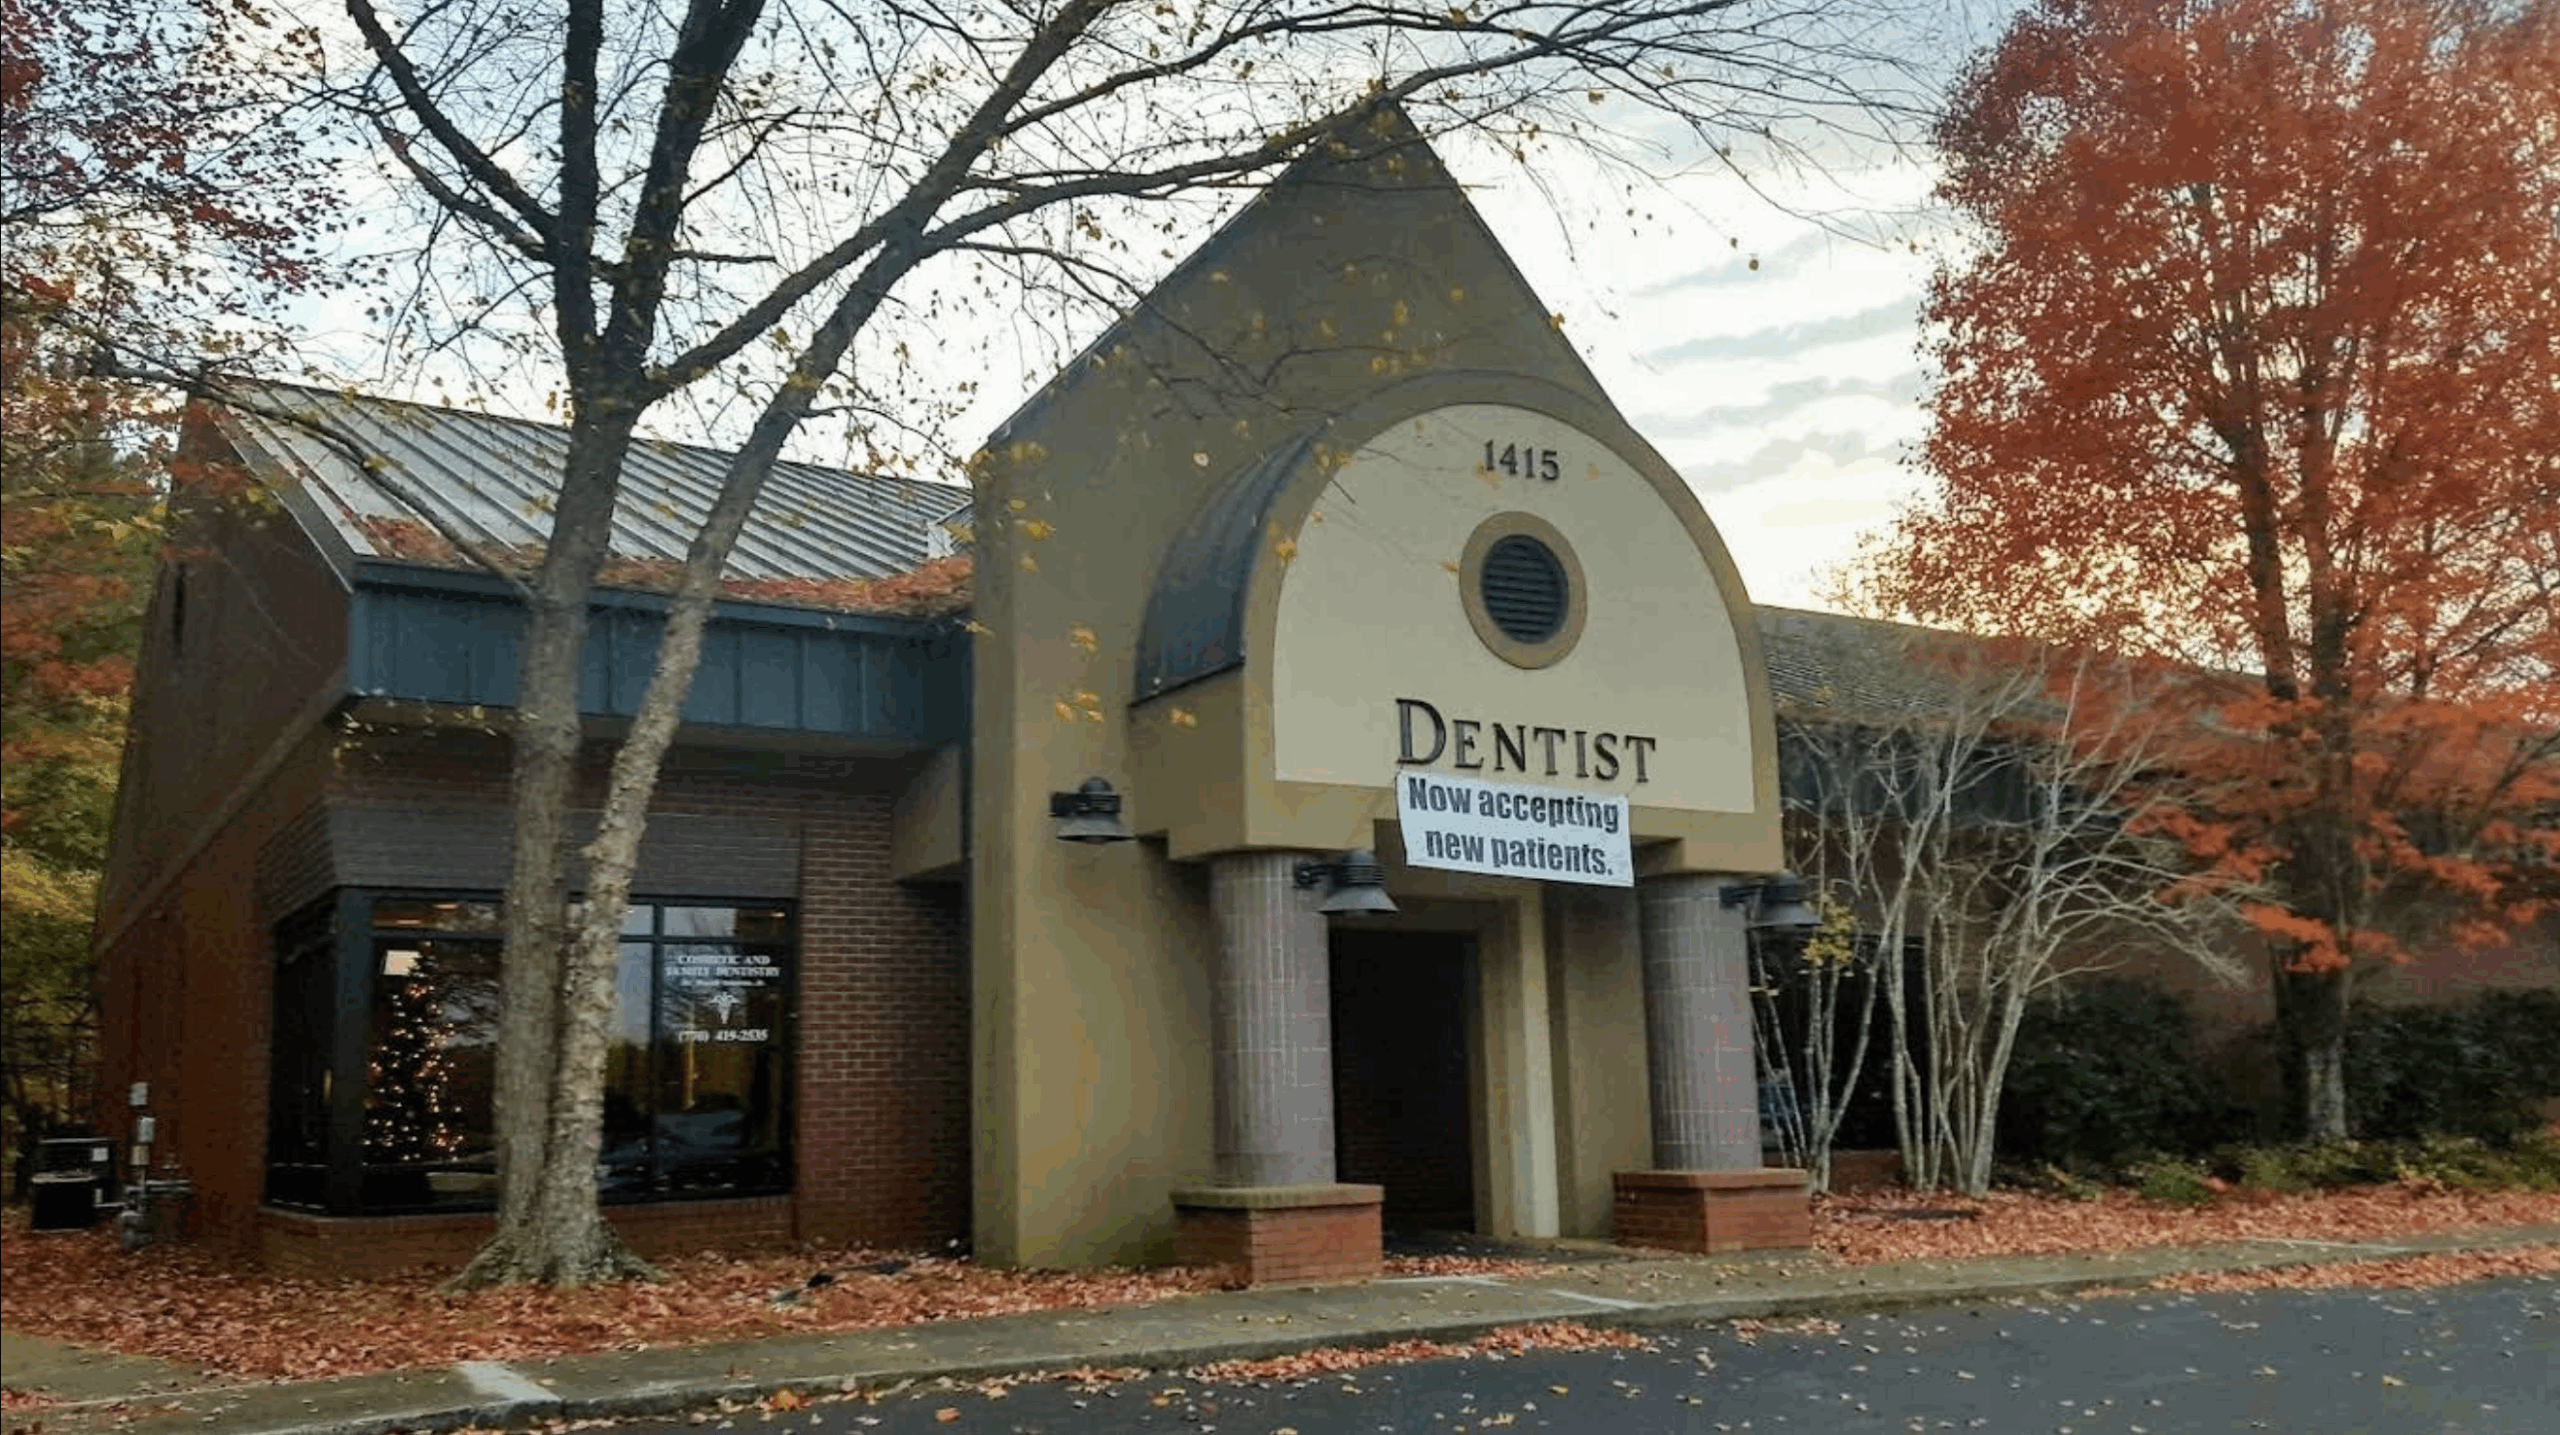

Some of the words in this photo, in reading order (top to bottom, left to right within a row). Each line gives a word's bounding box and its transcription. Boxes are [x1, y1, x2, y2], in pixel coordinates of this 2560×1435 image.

[1484, 439, 1560, 481] 1415
[1396, 698, 1656, 783] DENTIST
[1408, 777, 1471, 814] Now
[1478, 789, 1619, 834] accepting
[1425, 829, 1484, 863] new
[1490, 835, 1613, 876] patients.
[665, 966, 710, 977] FAMILY
[716, 966, 781, 977] DENTISTRY
[745, 955, 771, 965] AND
